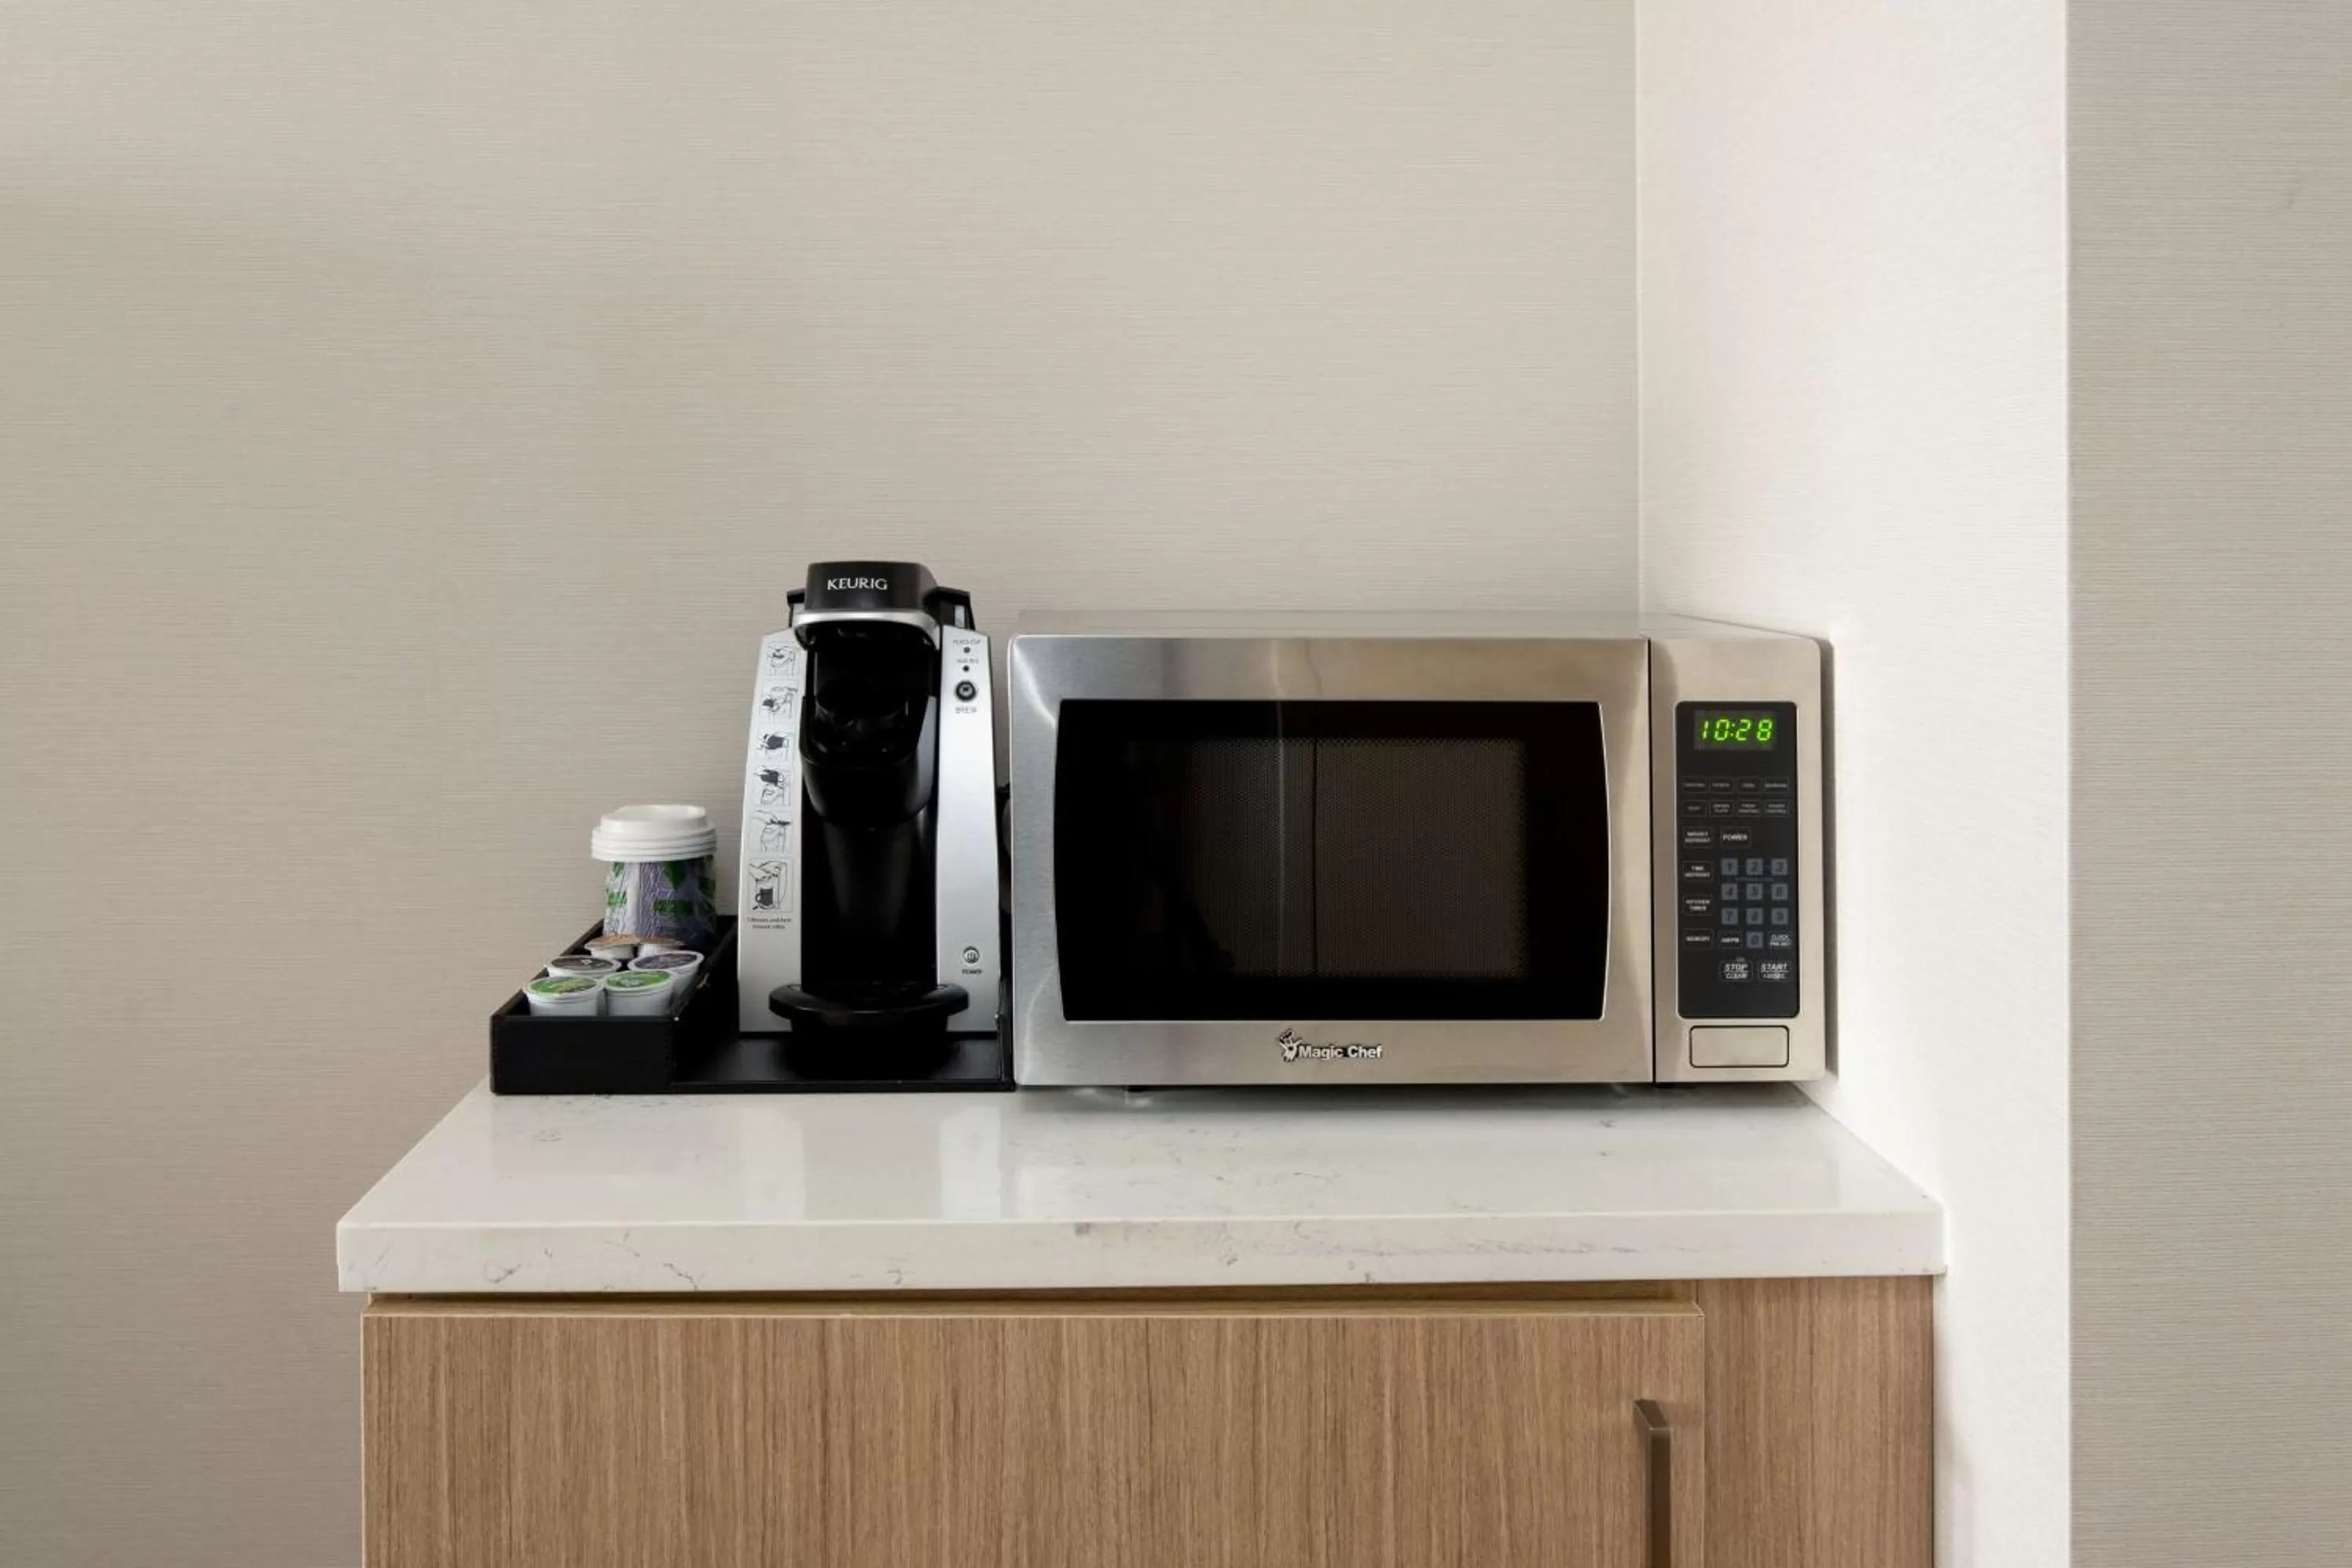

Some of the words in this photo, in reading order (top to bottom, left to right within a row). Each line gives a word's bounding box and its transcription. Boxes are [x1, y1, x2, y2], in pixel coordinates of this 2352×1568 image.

[827, 578, 887, 590] KEURIG
[1701, 719, 1773, 741] 10:28
[1299, 1045, 1344, 1060] Magic
[1347, 1044, 1383, 1058] Chef
